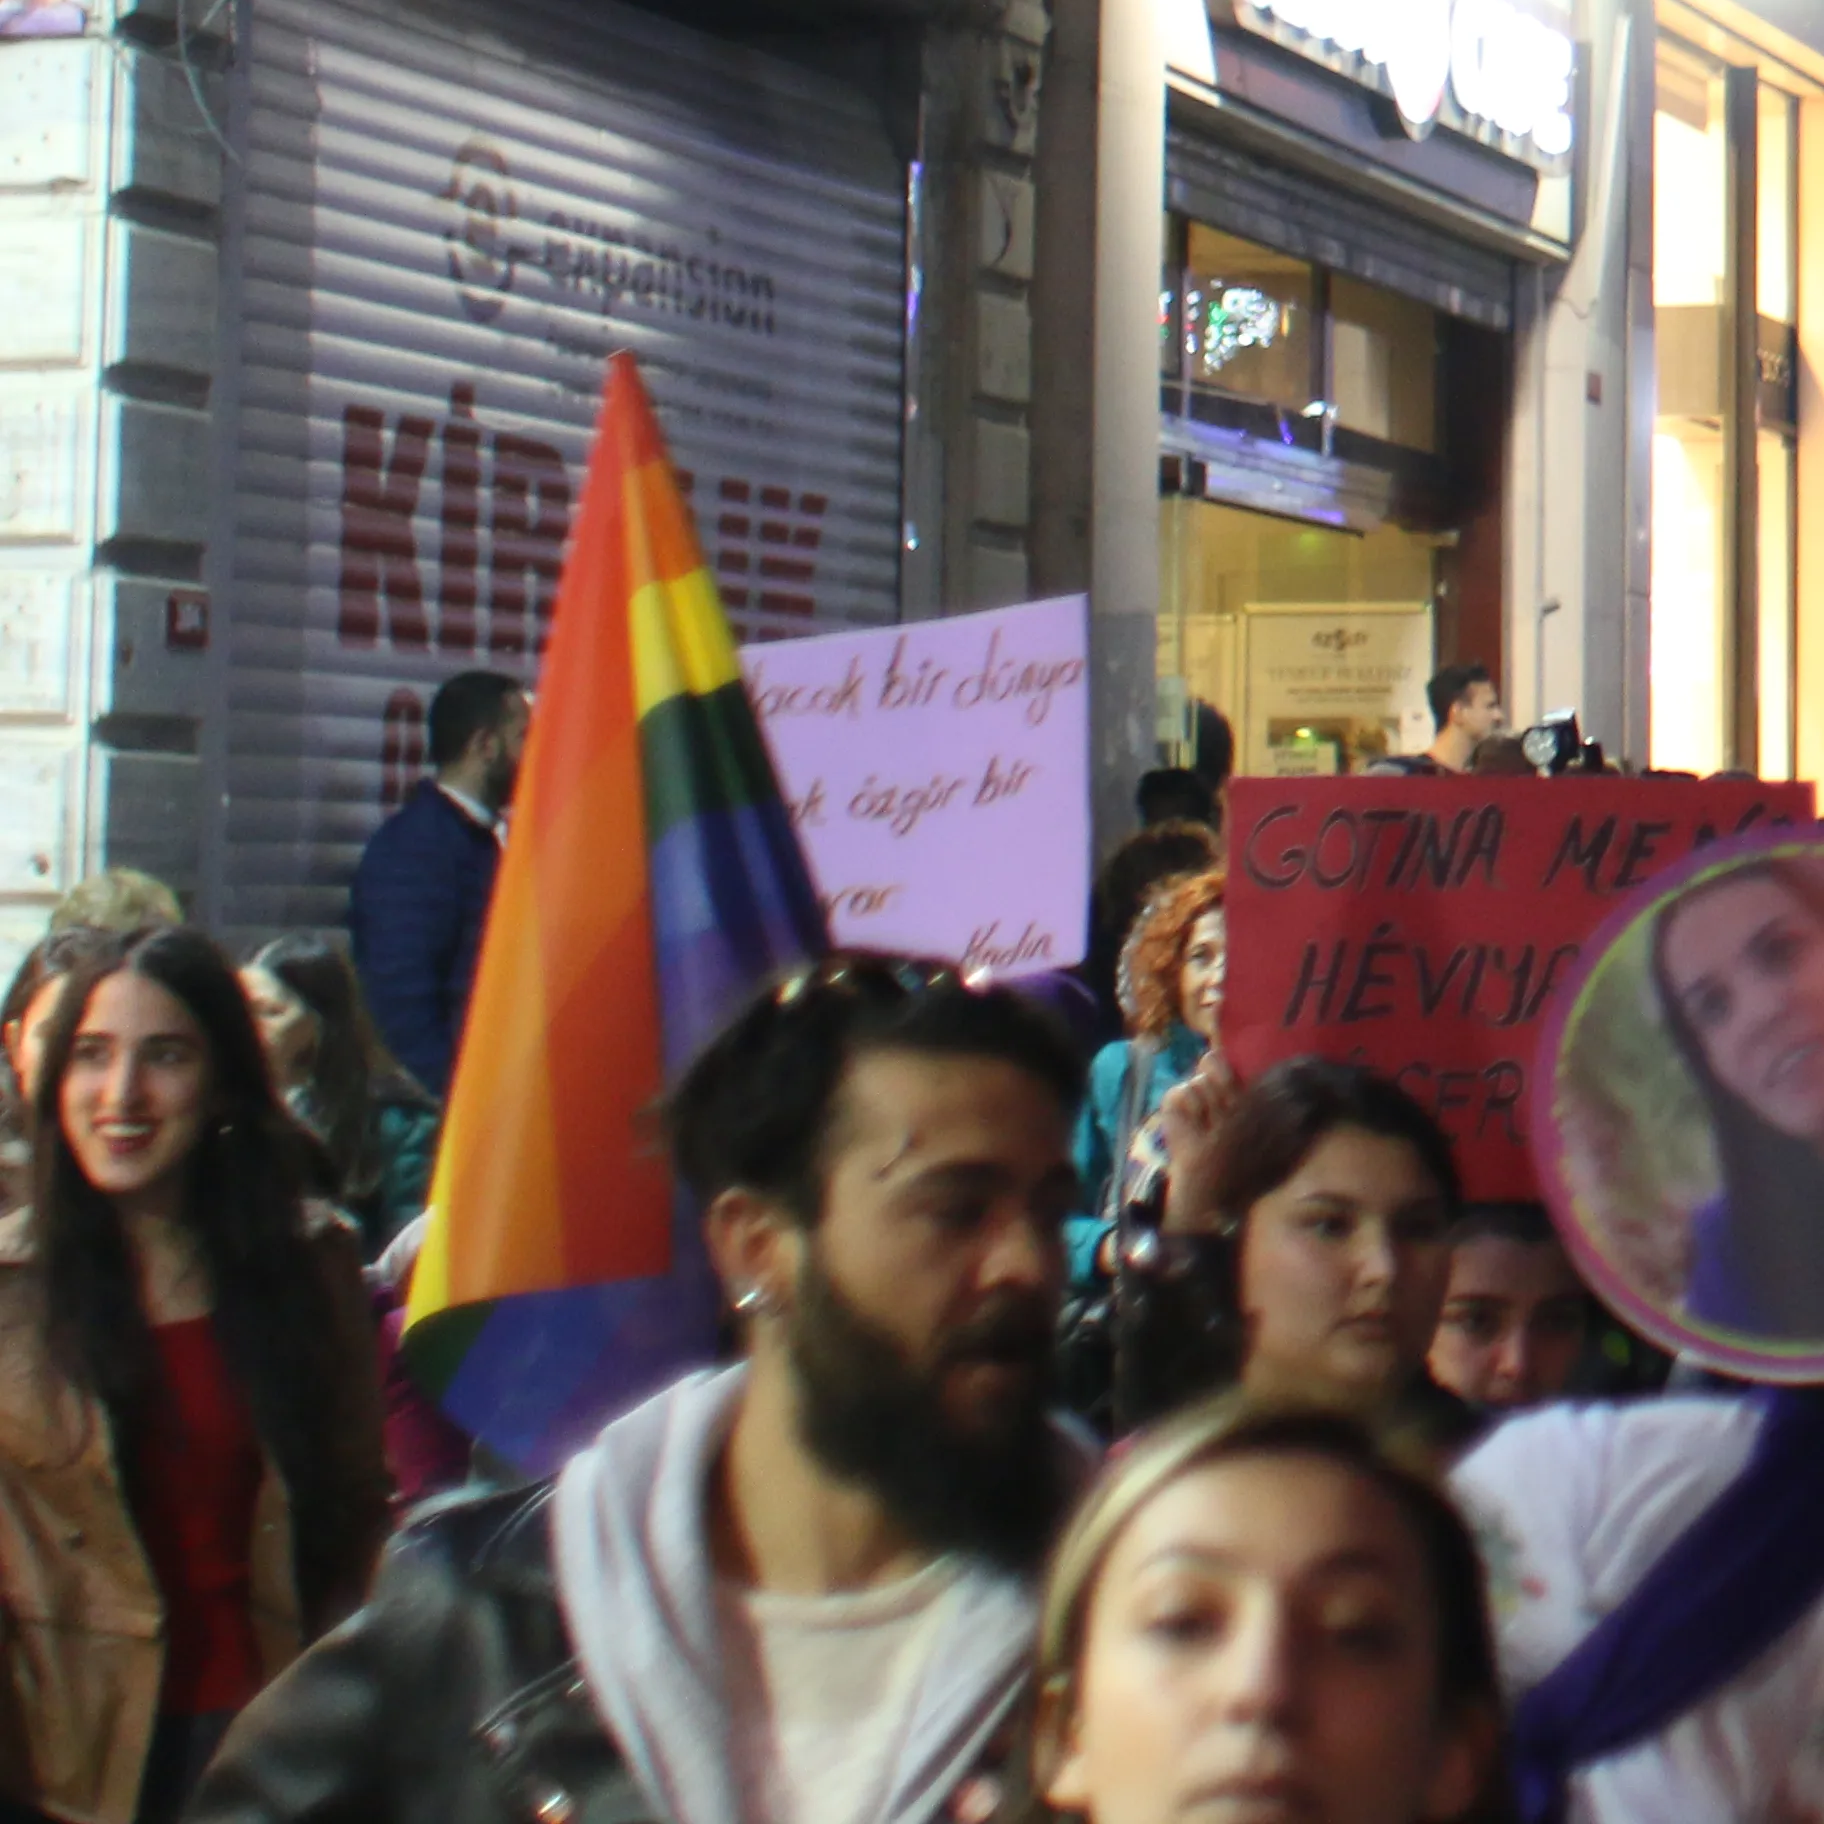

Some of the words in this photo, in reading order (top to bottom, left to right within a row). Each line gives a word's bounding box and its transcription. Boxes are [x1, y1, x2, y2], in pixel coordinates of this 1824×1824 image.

[877, 633, 949, 710] bir
[953, 624, 1086, 729] dünya
[848, 773, 967, 839] özgür
[972, 753, 1043, 807] bir
[1541, 812, 1672, 894] ME
